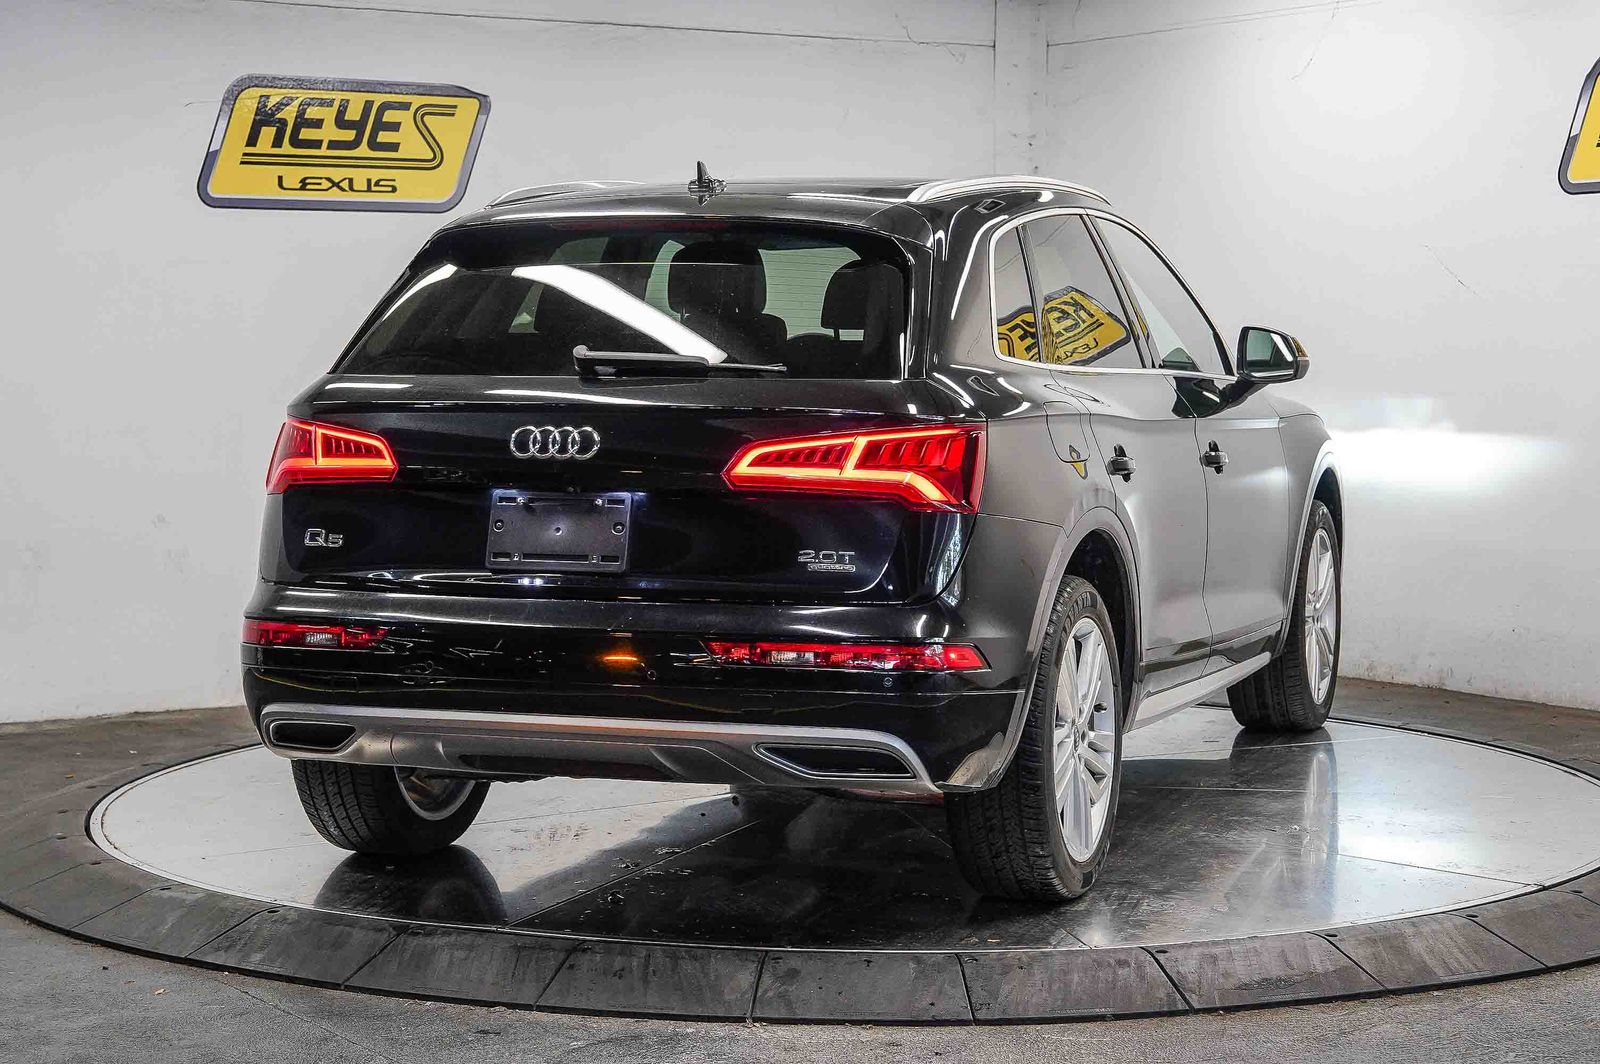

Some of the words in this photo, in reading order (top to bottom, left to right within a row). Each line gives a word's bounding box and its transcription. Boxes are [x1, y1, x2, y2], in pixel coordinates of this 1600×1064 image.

[240, 95, 458, 170] KEYES
[277, 175, 398, 194] LEXUS
[304, 528, 344, 548] Q5
[797, 549, 856, 564] 2.0T
